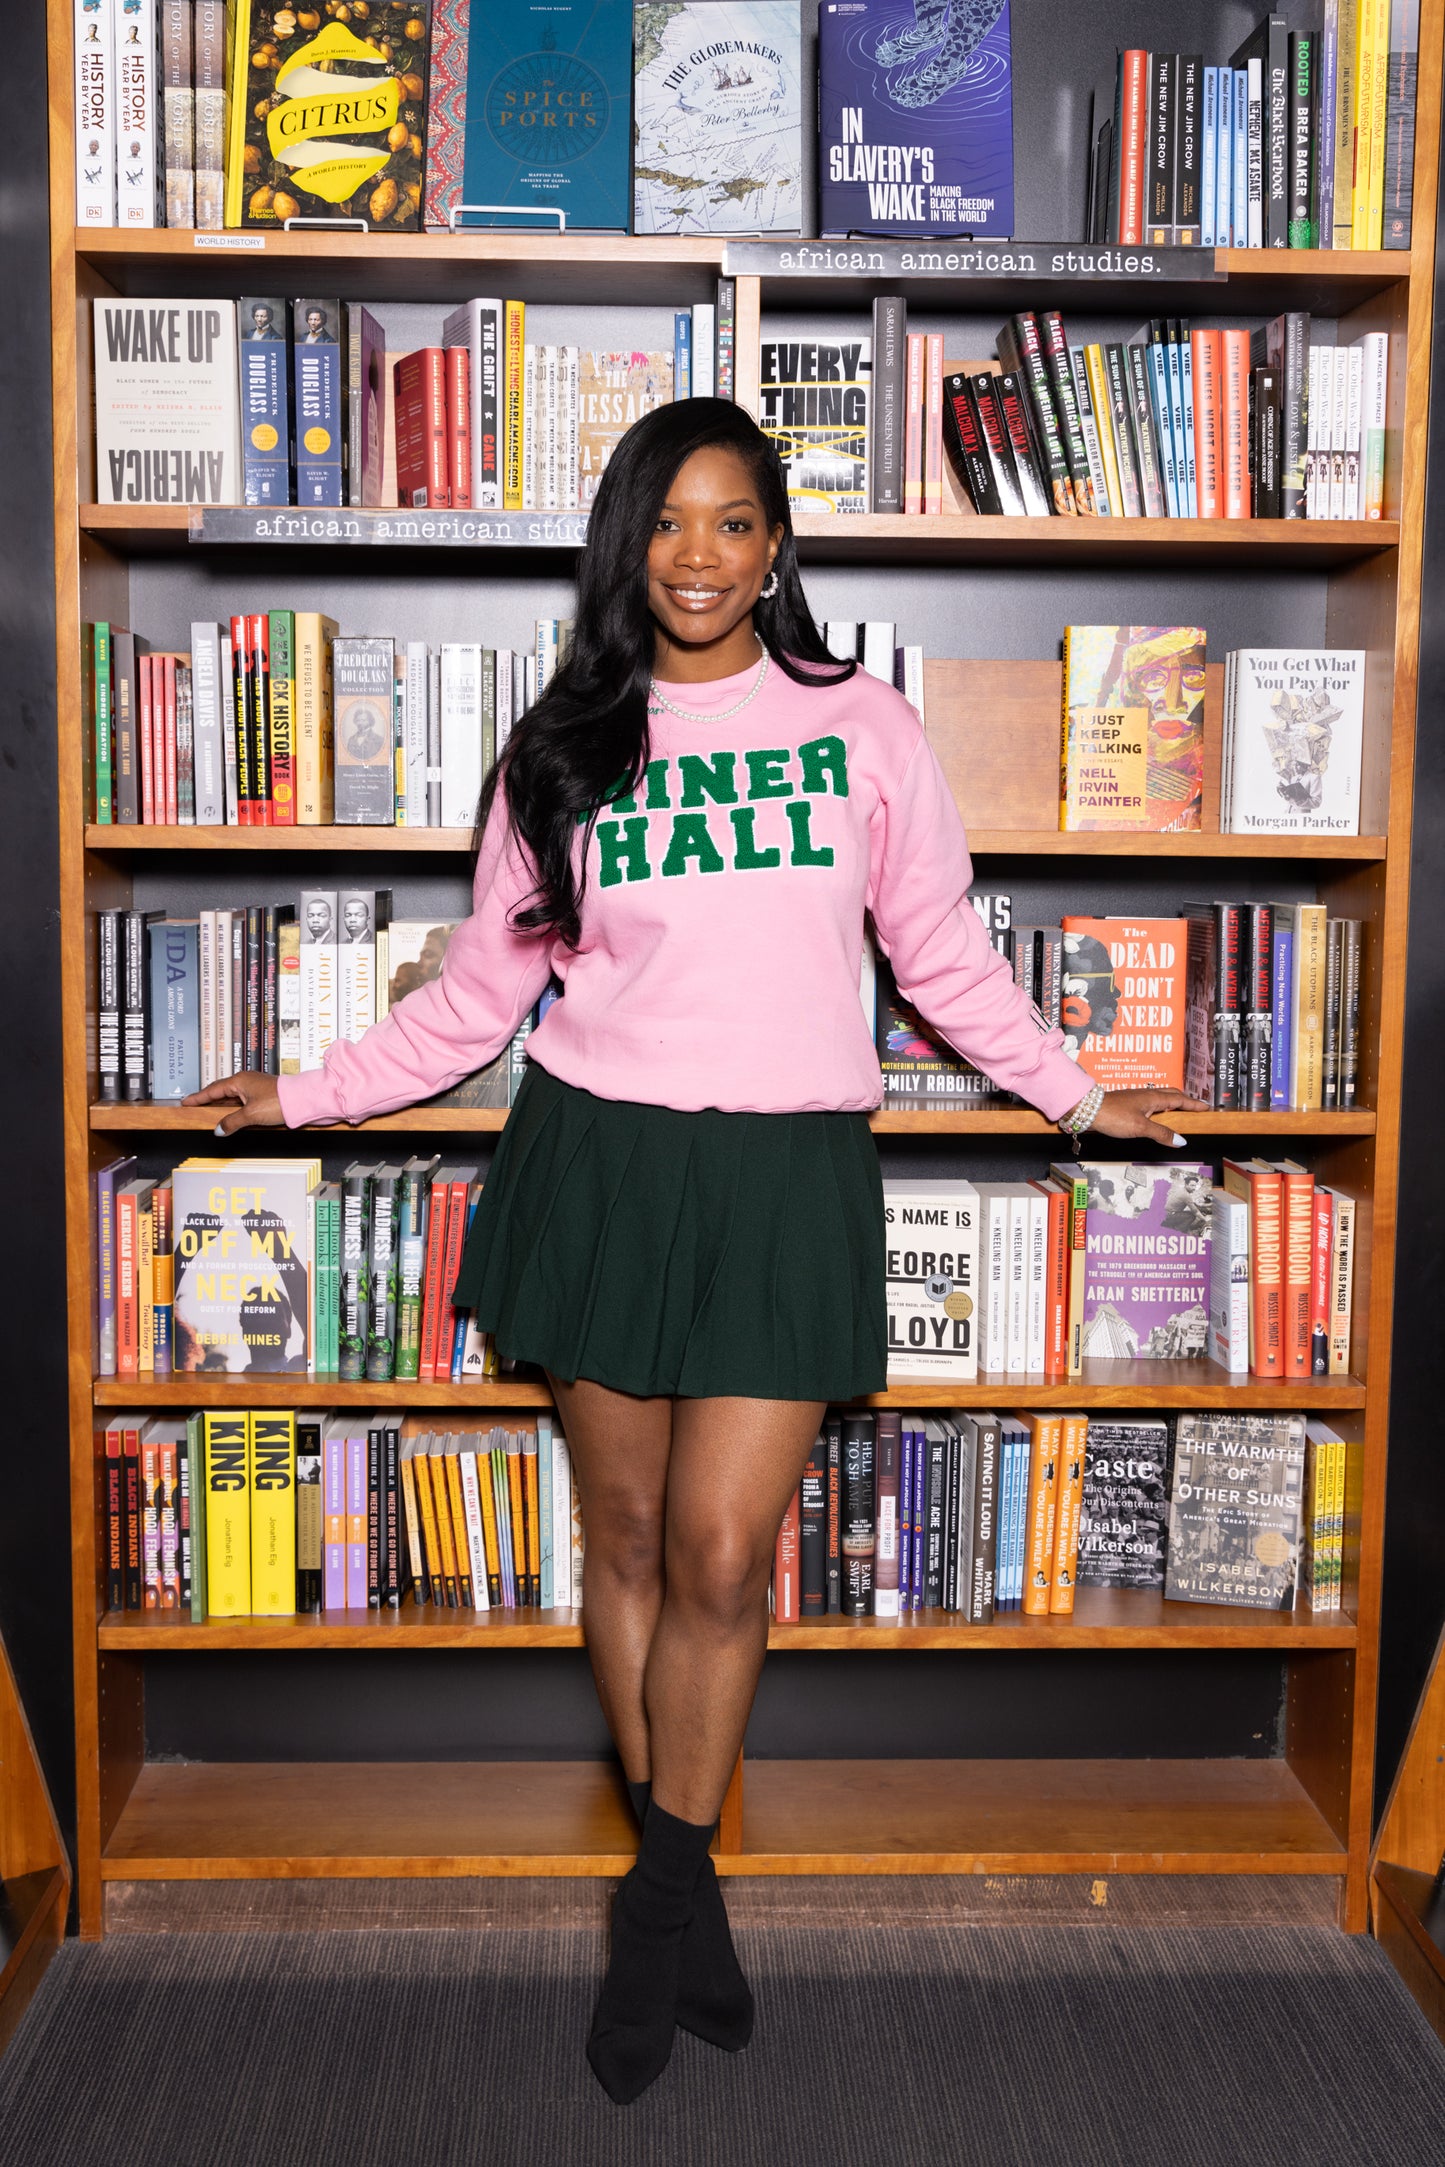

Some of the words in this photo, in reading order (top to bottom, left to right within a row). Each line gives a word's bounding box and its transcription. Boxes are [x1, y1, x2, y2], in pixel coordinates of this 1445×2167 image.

[662, 62, 692, 90] THE
[690, 41, 782, 65] GLOBEMAKERS
[1159, 62, 1168, 83] THE
[1298, 41, 1309, 97] ROOTED
[82, 86, 88, 102] BY
[91, 54, 104, 129] HISTORY
[505, 92, 593, 107] SPICE
[1159, 87, 1167, 111] NEW
[280, 96, 387, 135] CITRUS
[501, 112, 597, 128] PORTS
[700, 114, 730, 127] Peter
[733, 103, 780, 121] Bellerby
[842, 107, 862, 143] IN
[1297, 108, 1309, 144] BREA
[313, 165, 336, 175] WORLD
[830, 146, 934, 183] SLAVERY'S
[1296, 150, 1307, 197] BAKER
[868, 183, 925, 221] WAKE
[930, 186, 961, 197] MAKING
[930, 198, 955, 209] BLACK
[958, 199, 994, 210] FREEDOM
[931, 210, 939, 221] IN
[942, 210, 955, 221] THE
[958, 211, 986, 222] WORLD
[197, 237, 226, 245] WORLD
[227, 238, 260, 246] HISTORY
[779, 248, 886, 270] african
[900, 251, 1036, 270] american
[1052, 254, 1161, 273] studies.
[105, 309, 180, 362] WAKE
[187, 310, 220, 363] UP
[484, 323, 495, 350] THE
[886, 308, 894, 338] SARAH
[1023, 320, 1038, 355] BLACK
[484, 355, 495, 397] GRIFT
[761, 344, 872, 382] EVERY-
[1030, 352, 1045, 382] LIVES,
[249, 355, 267, 413] DOUGLASS
[605, 371, 627, 388] THE
[885, 384, 893, 400] THE
[1204, 372, 1212, 400] MILES
[760, 388, 866, 427] THING
[1037, 385, 1057, 433] AMERICAN
[885, 402, 893, 441] UNSEEN
[952, 395, 977, 444] MALCOLM
[966, 446, 979, 454] X
[1203, 410, 1214, 446] NIGHT
[483, 435, 494, 471] CANE
[884, 442, 892, 473] TRUTH
[1050, 436, 1061, 459] LOVE
[109, 450, 224, 503] AMERICA
[1204, 454, 1215, 491] FLYER
[256, 517, 361, 537] african
[378, 518, 512, 540] american
[528, 518, 587, 540] stud
[196, 639, 213, 682] ANGELA
[339, 654, 388, 667] FREDERICK
[1248, 658, 1278, 672] You
[1284, 658, 1311, 671] Get
[1316, 659, 1356, 672] What
[341, 670, 386, 683] DOUGLASS
[1255, 676, 1286, 690] You
[1290, 677, 1318, 693] Pay
[1322, 678, 1350, 690] For
[199, 685, 214, 728] DAVIS
[1090, 715, 1124, 726] JUST
[274, 705, 289, 773] HISTORY
[1080, 730, 1120, 740] KEEP
[1080, 744, 1142, 754] TALKING
[1079, 769, 1116, 778] NELL
[1080, 783, 1118, 792] IRVIN
[1079, 797, 1142, 806] PAINTER
[1243, 816, 1297, 830] Morgan
[1303, 817, 1350, 828] Parker
[596, 801, 834, 888] HALL
[1123, 928, 1147, 936] The
[1226, 910, 1238, 954] MEDGAR
[166, 931, 186, 984] IDA
[1110, 942, 1175, 968] DEAD
[1226, 958, 1234, 966] &
[1125, 978, 1174, 998] DON'T
[1225, 970, 1238, 1009] MYRLIE
[101, 1012, 118, 1028] THE
[1120, 1006, 1173, 1027] NEED
[101, 1029, 118, 1056] BLACK
[1085, 1034, 1173, 1053] REMINDING
[101, 1057, 118, 1072] BOX
[882, 1075, 920, 1091] EMILY
[208, 1187, 267, 1215] GET
[1258, 1194, 1279, 1216] AM
[345, 1196, 361, 1260] MADNESS
[903, 1209, 948, 1225] NAME
[956, 1212, 971, 1226] IS
[180, 1230, 237, 1257] OFF
[252, 1231, 296, 1258] MY
[993, 1228, 1001, 1262] KNEELING
[1088, 1235, 1206, 1255] MORNINGSIDE
[1257, 1221, 1280, 1284] MAROON
[888, 1251, 970, 1278] EORGE
[196, 1274, 281, 1302] NECK
[1087, 1286, 1124, 1301] ARAN
[1132, 1287, 1205, 1302] SHETTERLY
[196, 1334, 238, 1345] DEBBIE
[244, 1335, 281, 1345] HINES
[889, 1316, 970, 1349] LOYD
[1040, 1427, 1049, 1456] WILEY
[1183, 1438, 1216, 1455] THE
[1222, 1442, 1299, 1462] WARMTH
[210, 1421, 246, 1491] KING
[983, 1433, 994, 1484] SAYING
[1228, 1468, 1250, 1481] OF
[981, 1487, 992, 1502] IT
[1179, 1484, 1239, 1503] OTHER
[1247, 1490, 1296, 1508] SUNS
[981, 1504, 990, 1540] LOUD
[1086, 1520, 1137, 1535] Isabel
[850, 1561, 859, 1597] SWIFT
[862, 1564, 870, 1593] EARL
[1200, 1562, 1265, 1577] ISABEL
[974, 1558, 984, 1618] WHITAKER
[984, 1572, 992, 1605] MARK
[1177, 1579, 1284, 1598] WILKERSON
